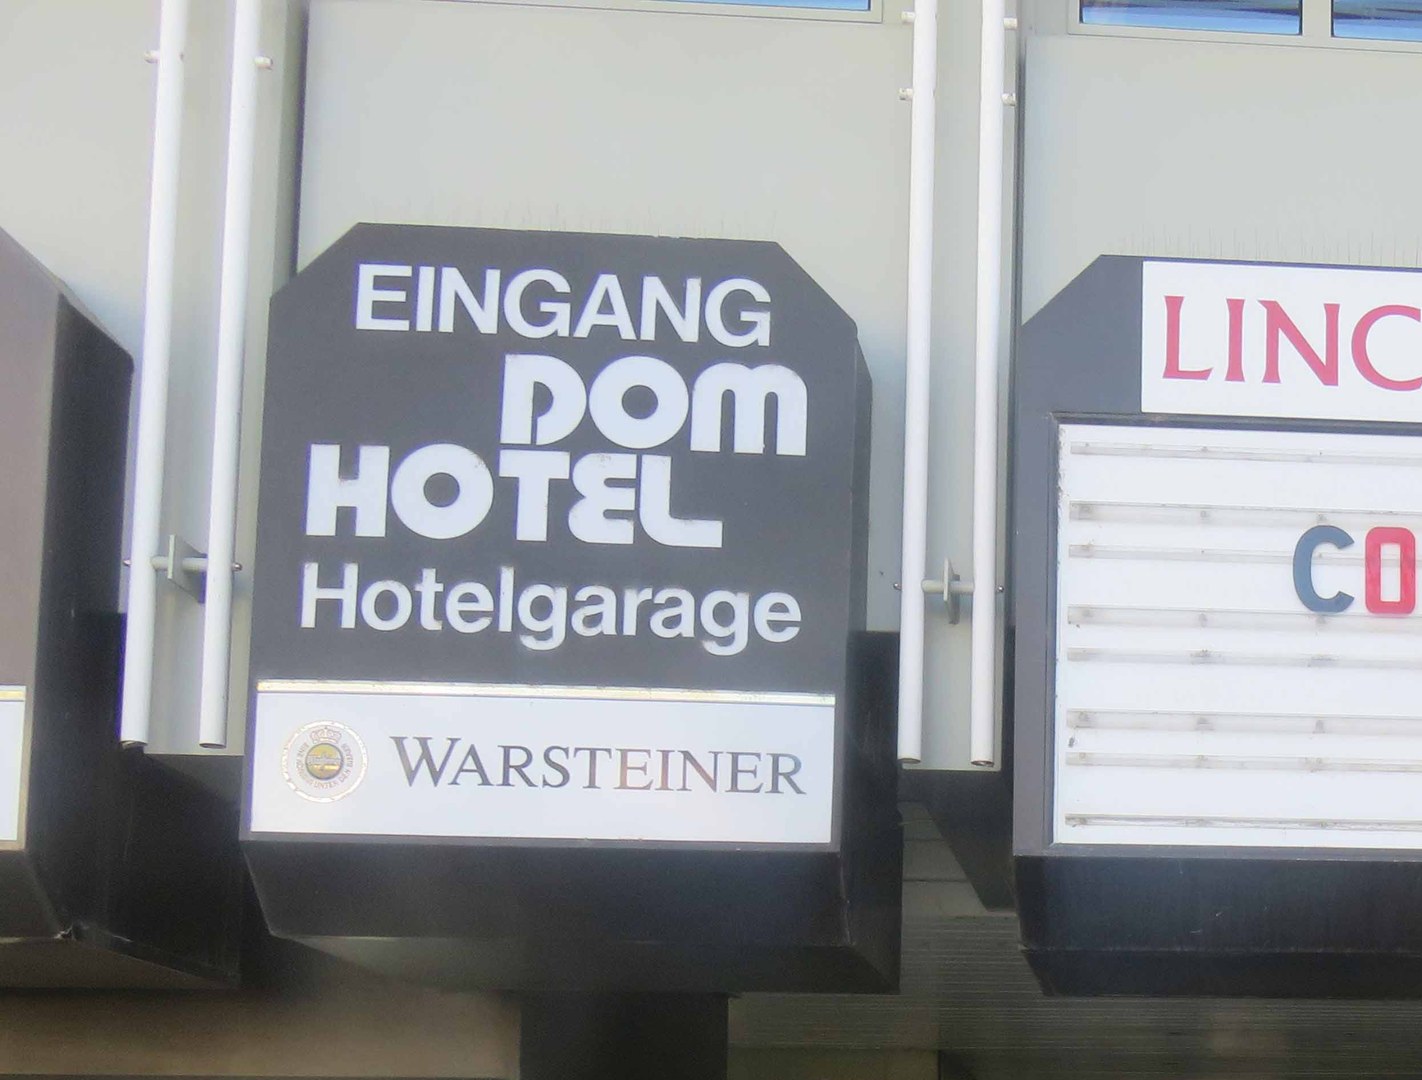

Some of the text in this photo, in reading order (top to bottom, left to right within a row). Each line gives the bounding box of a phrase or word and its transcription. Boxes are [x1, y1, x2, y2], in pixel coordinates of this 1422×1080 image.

[355, 262, 772, 347] EINGANG
[500, 353, 808, 456] DOM
[305, 443, 723, 549] HOTEL
[300, 563, 803, 658] Hotelgarage
[390, 735, 807, 798] WARSTEINER
